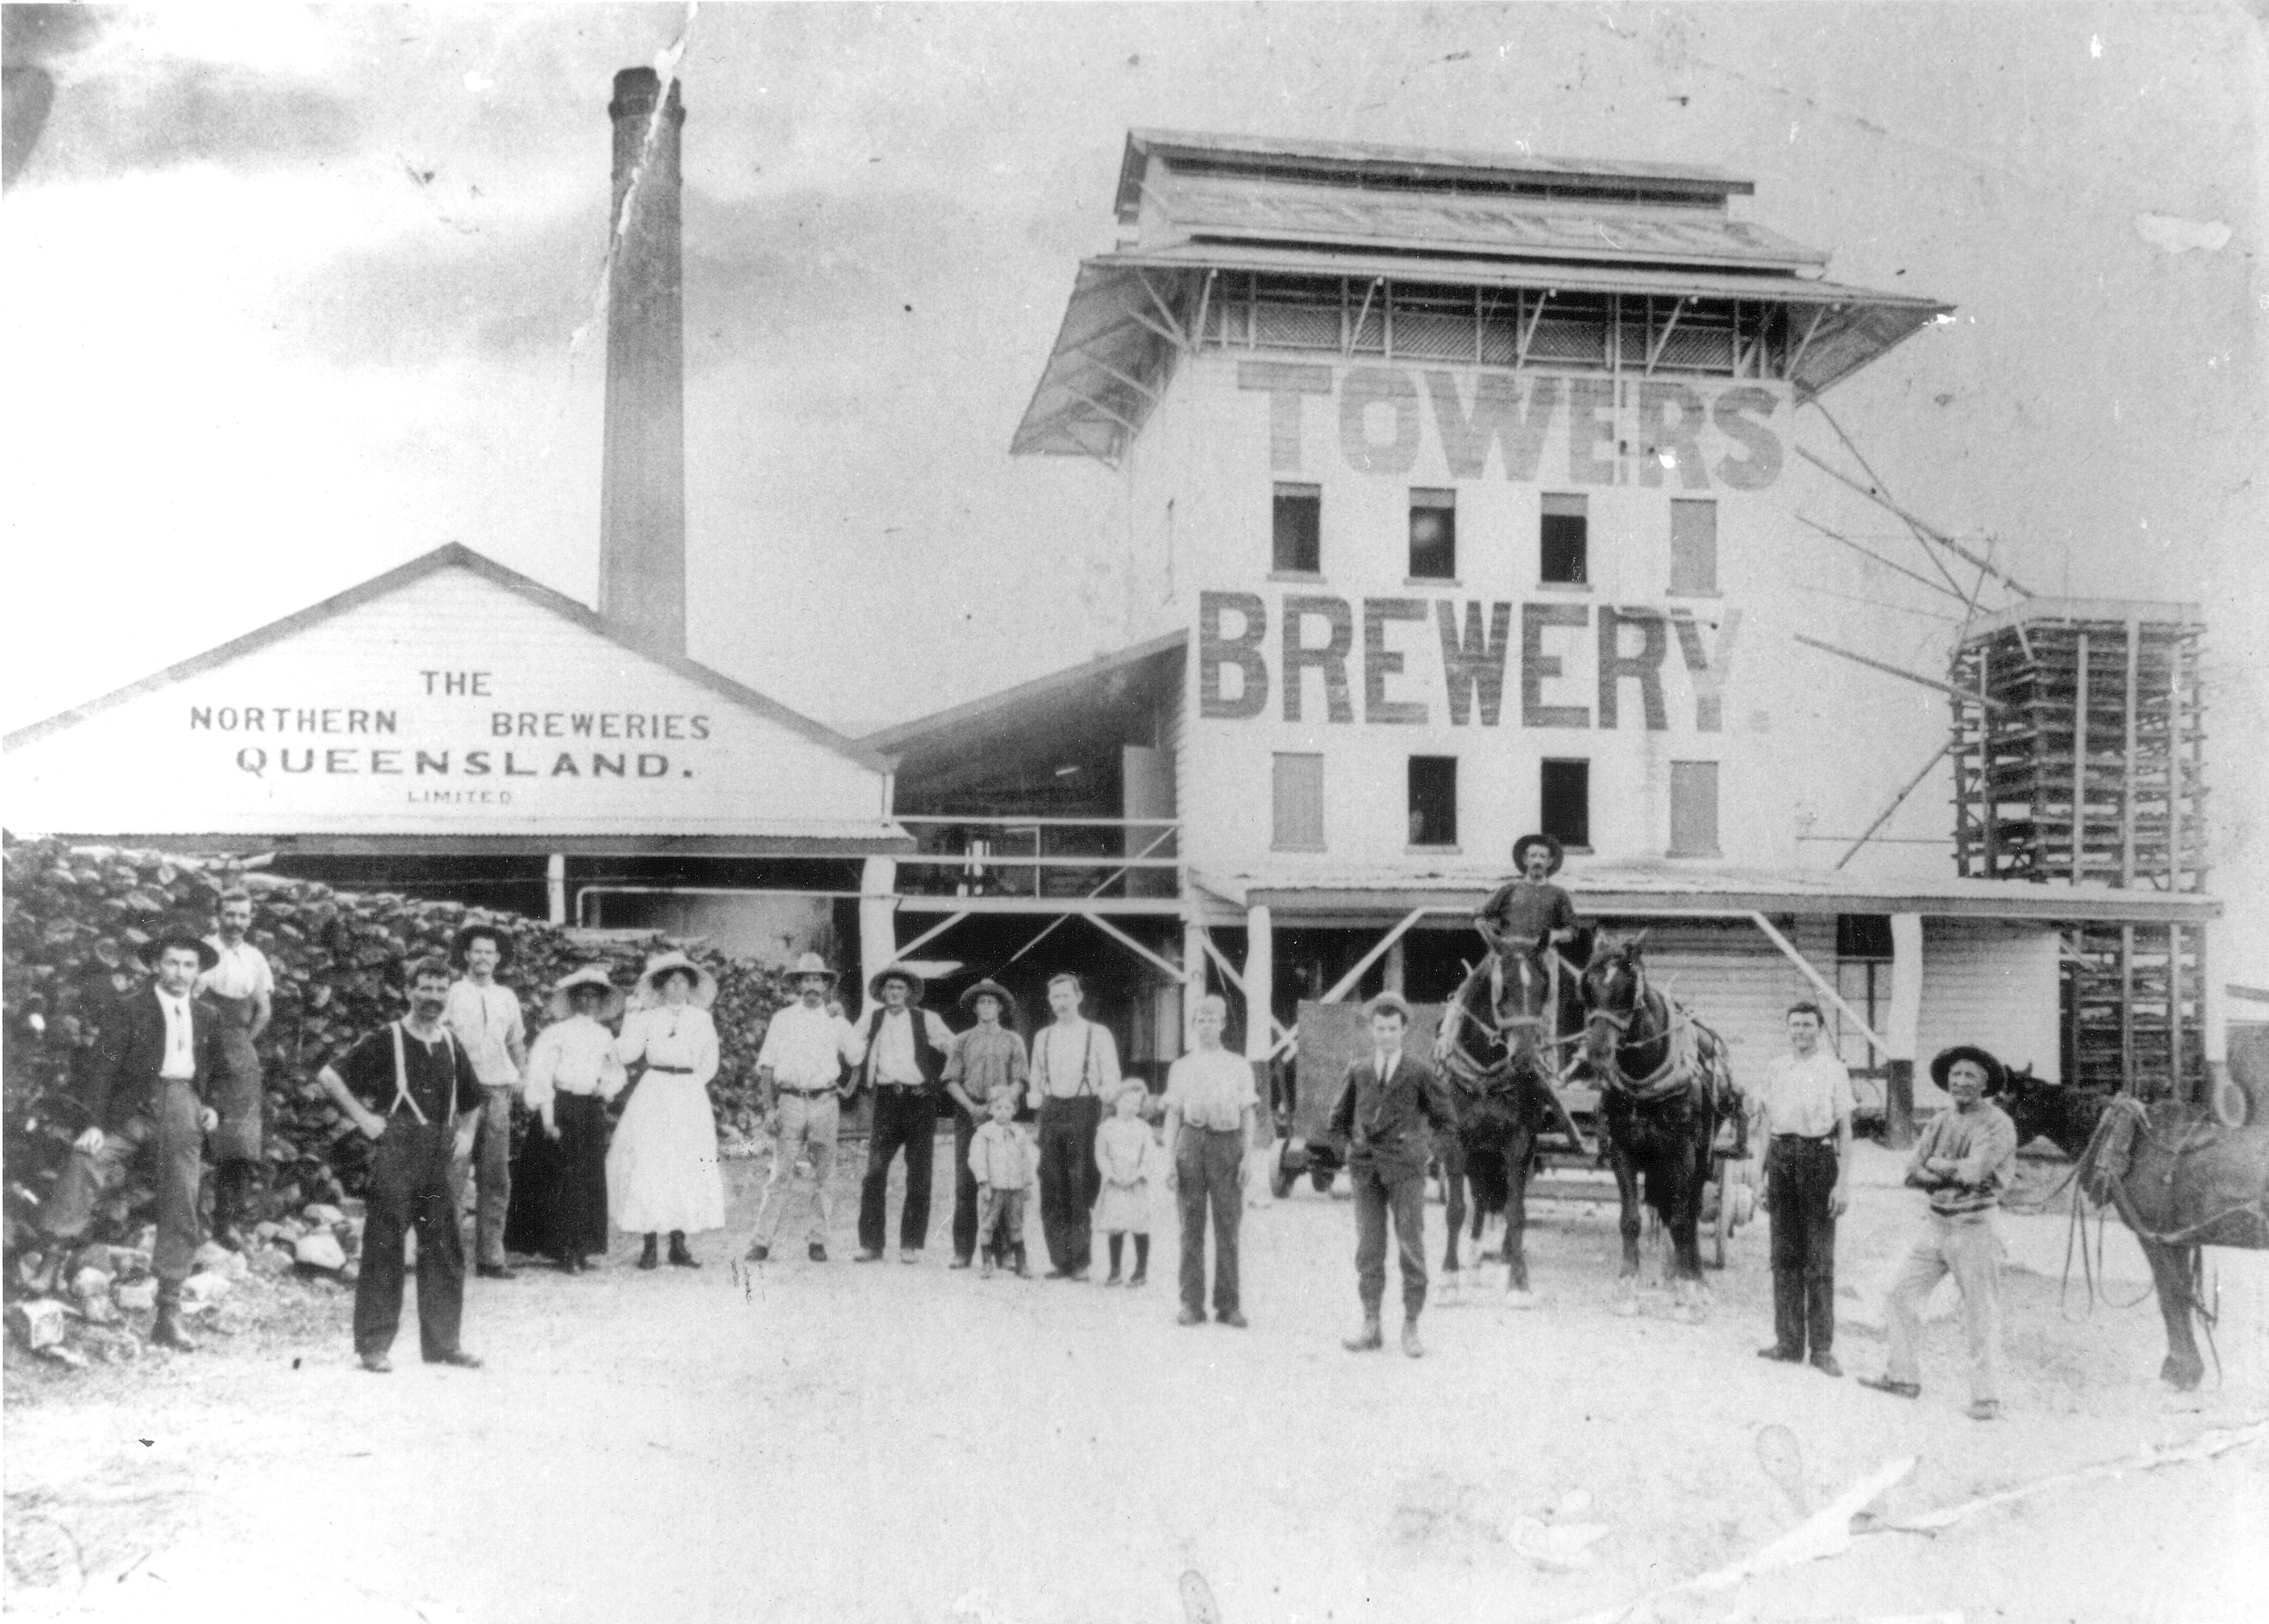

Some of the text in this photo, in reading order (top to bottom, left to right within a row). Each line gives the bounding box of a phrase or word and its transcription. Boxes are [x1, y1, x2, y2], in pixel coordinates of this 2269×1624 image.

[1238, 359, 1783, 491] TOWERS
[421, 671, 492, 697] THE
[190, 706, 710, 741] NORTHERN BREWERIES
[236, 747, 693, 778] QUEENSLAND.
[408, 790, 512, 805] LIMITED
